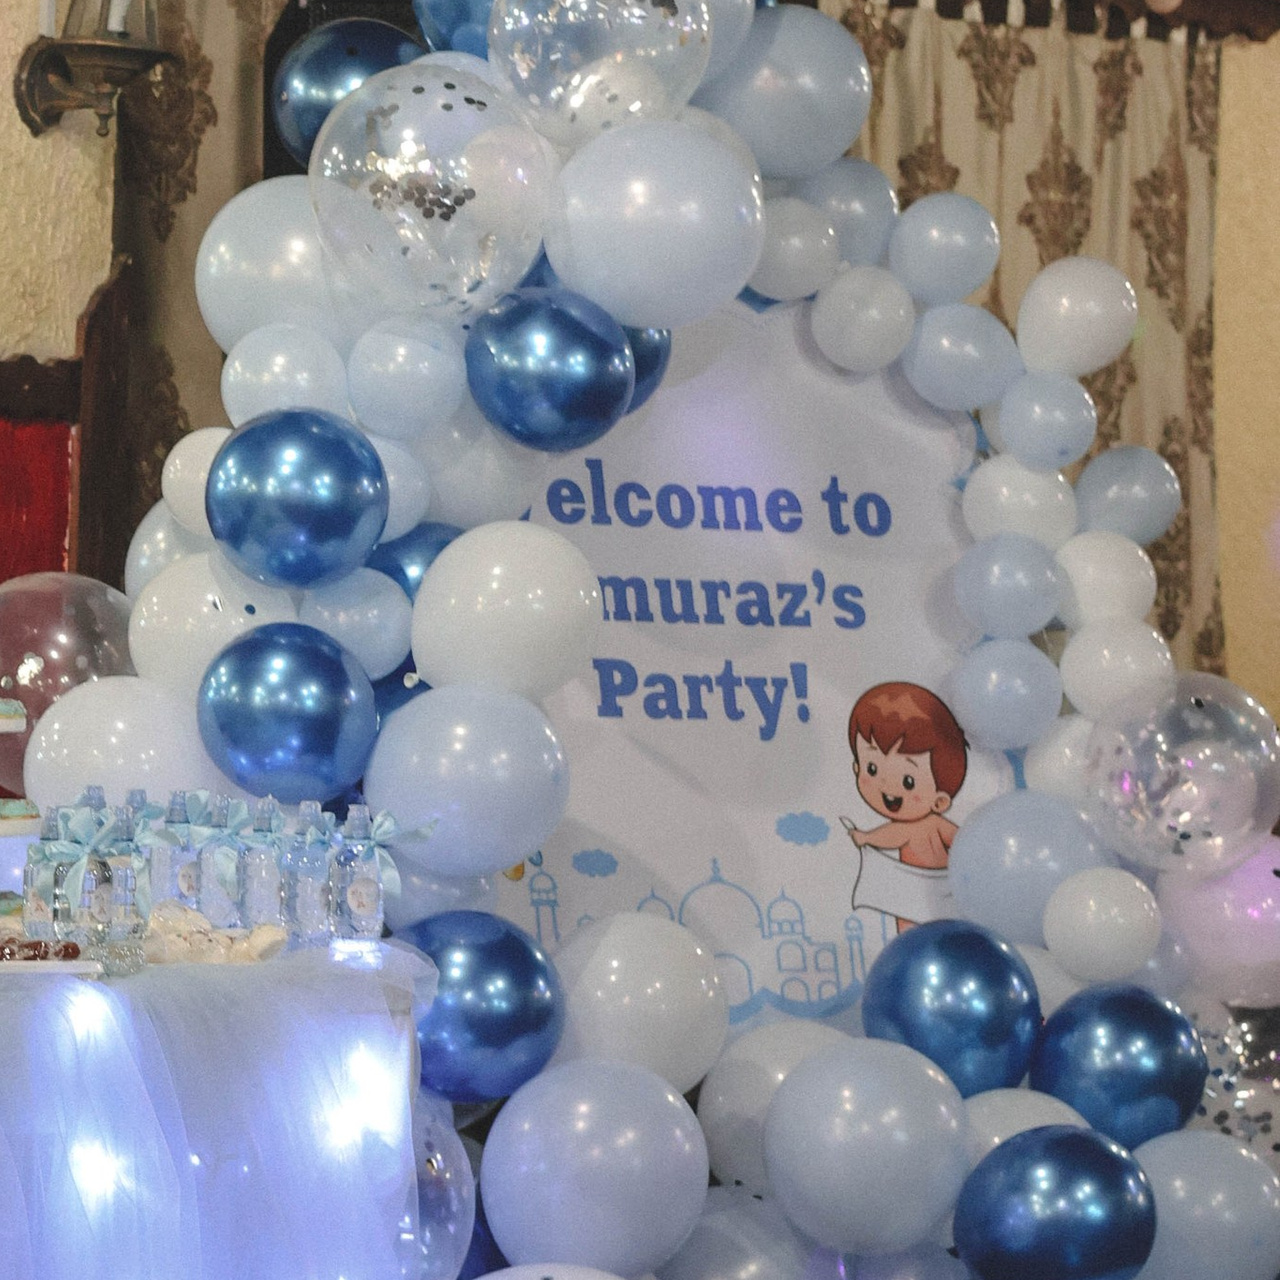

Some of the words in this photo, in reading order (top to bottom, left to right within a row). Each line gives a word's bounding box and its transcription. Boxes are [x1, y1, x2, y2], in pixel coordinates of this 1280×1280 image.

[519, 457, 803, 533] elcome
[821, 475, 892, 537] to
[597, 569, 866, 629] muraz's
[592, 657, 810, 741] Party!
